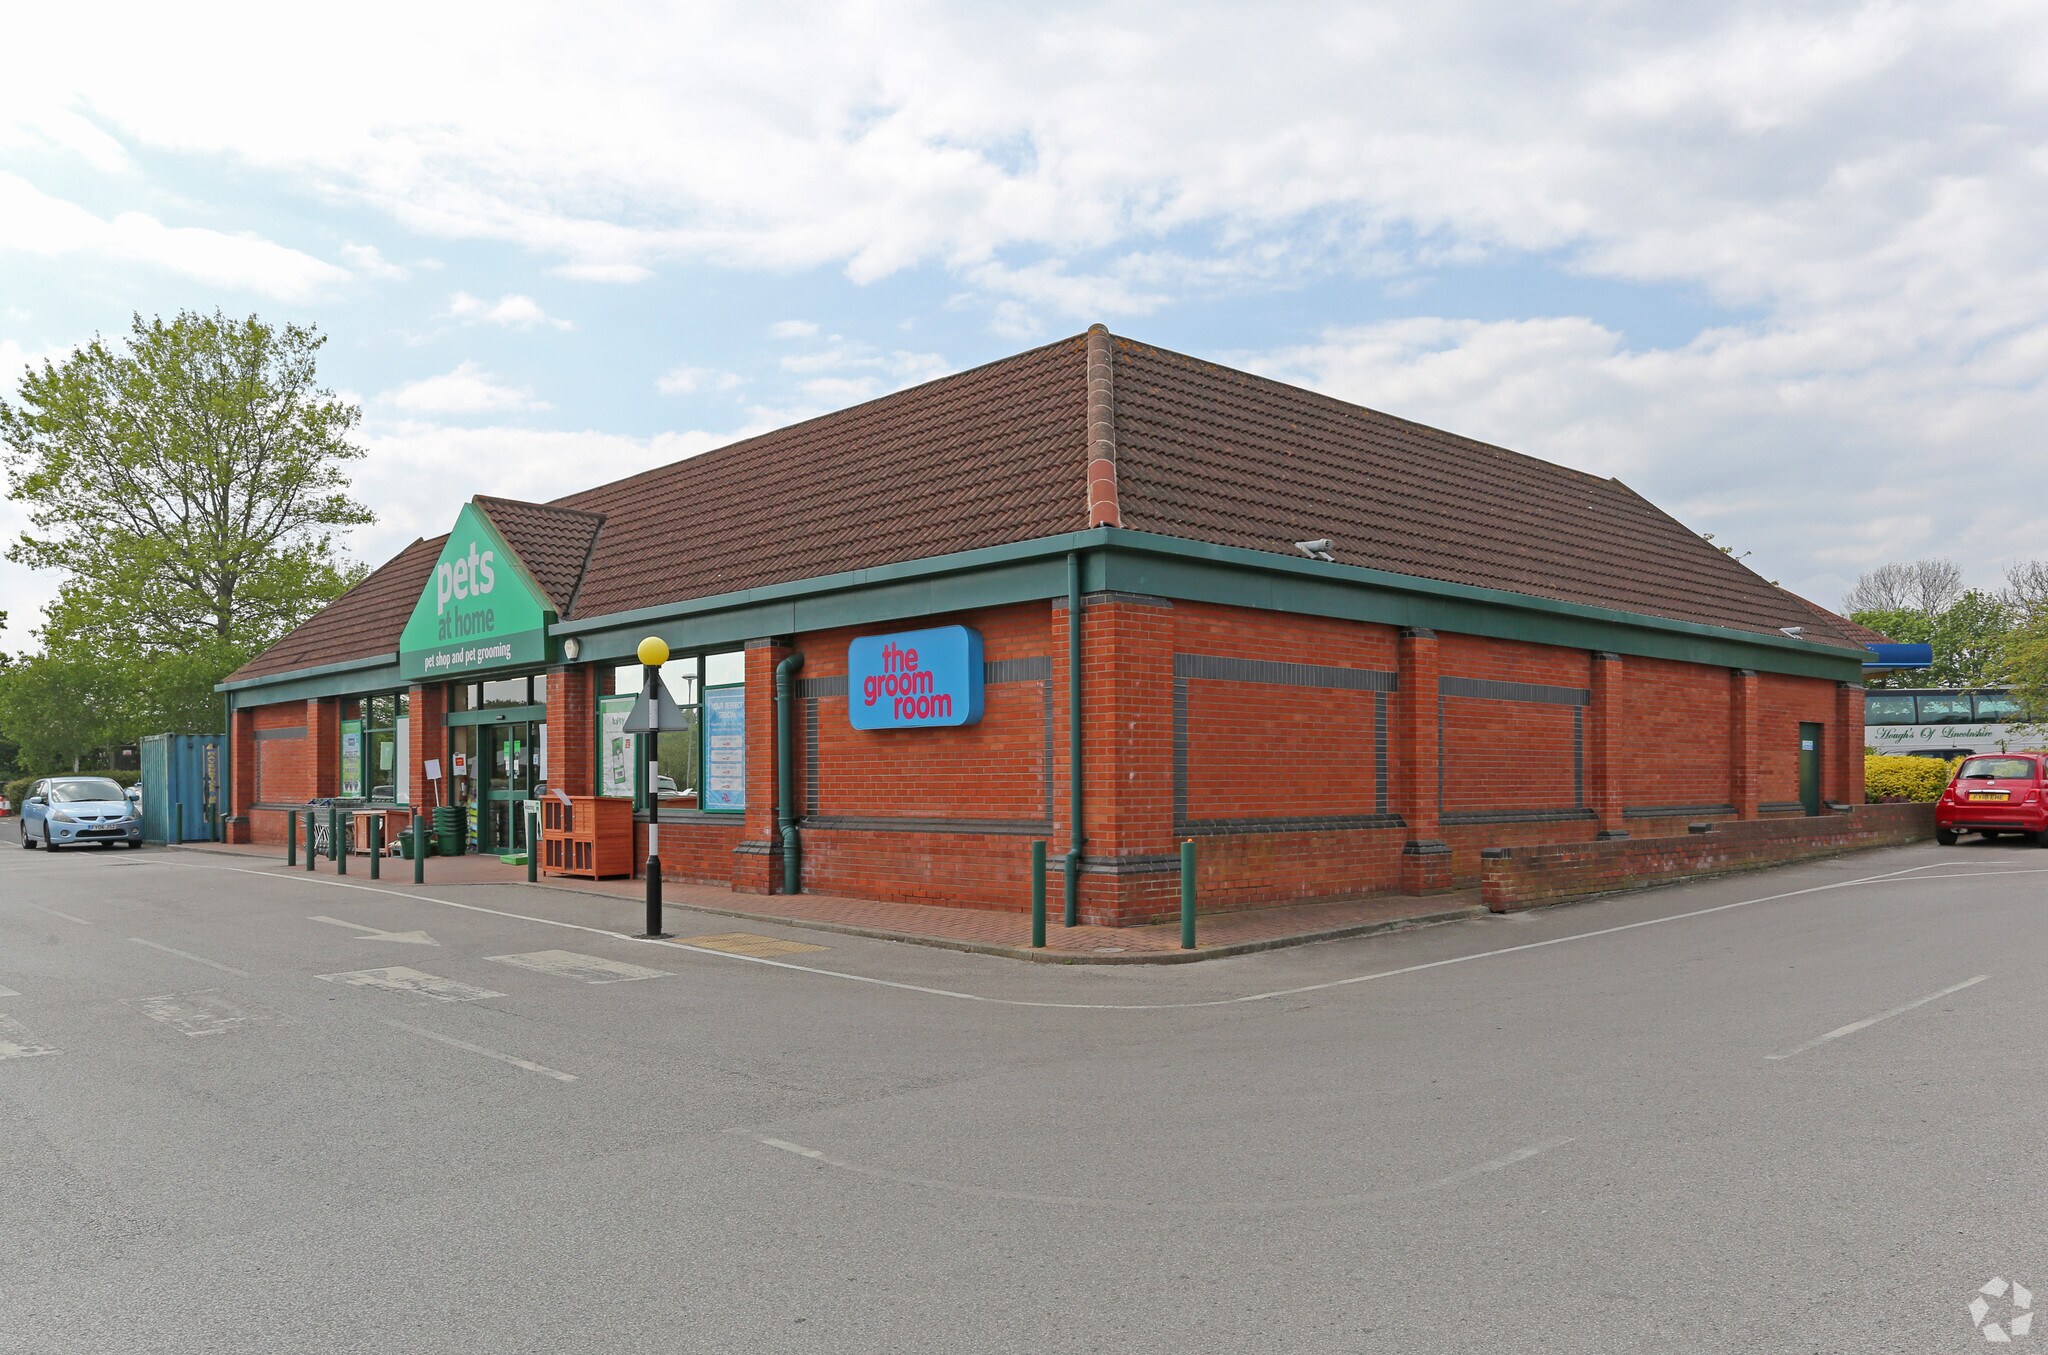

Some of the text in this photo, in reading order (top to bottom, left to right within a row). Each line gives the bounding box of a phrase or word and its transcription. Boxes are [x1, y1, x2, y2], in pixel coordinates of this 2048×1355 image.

[437, 541, 494, 616] pets
[438, 605, 495, 641] at home
[424, 642, 512, 672] pet shop and pet grooming
[882, 642, 918, 673] the
[864, 671, 933, 706] groom
[894, 694, 952, 720] room
[1875, 726, 1992, 744] Hough's Of Lincolnshire
